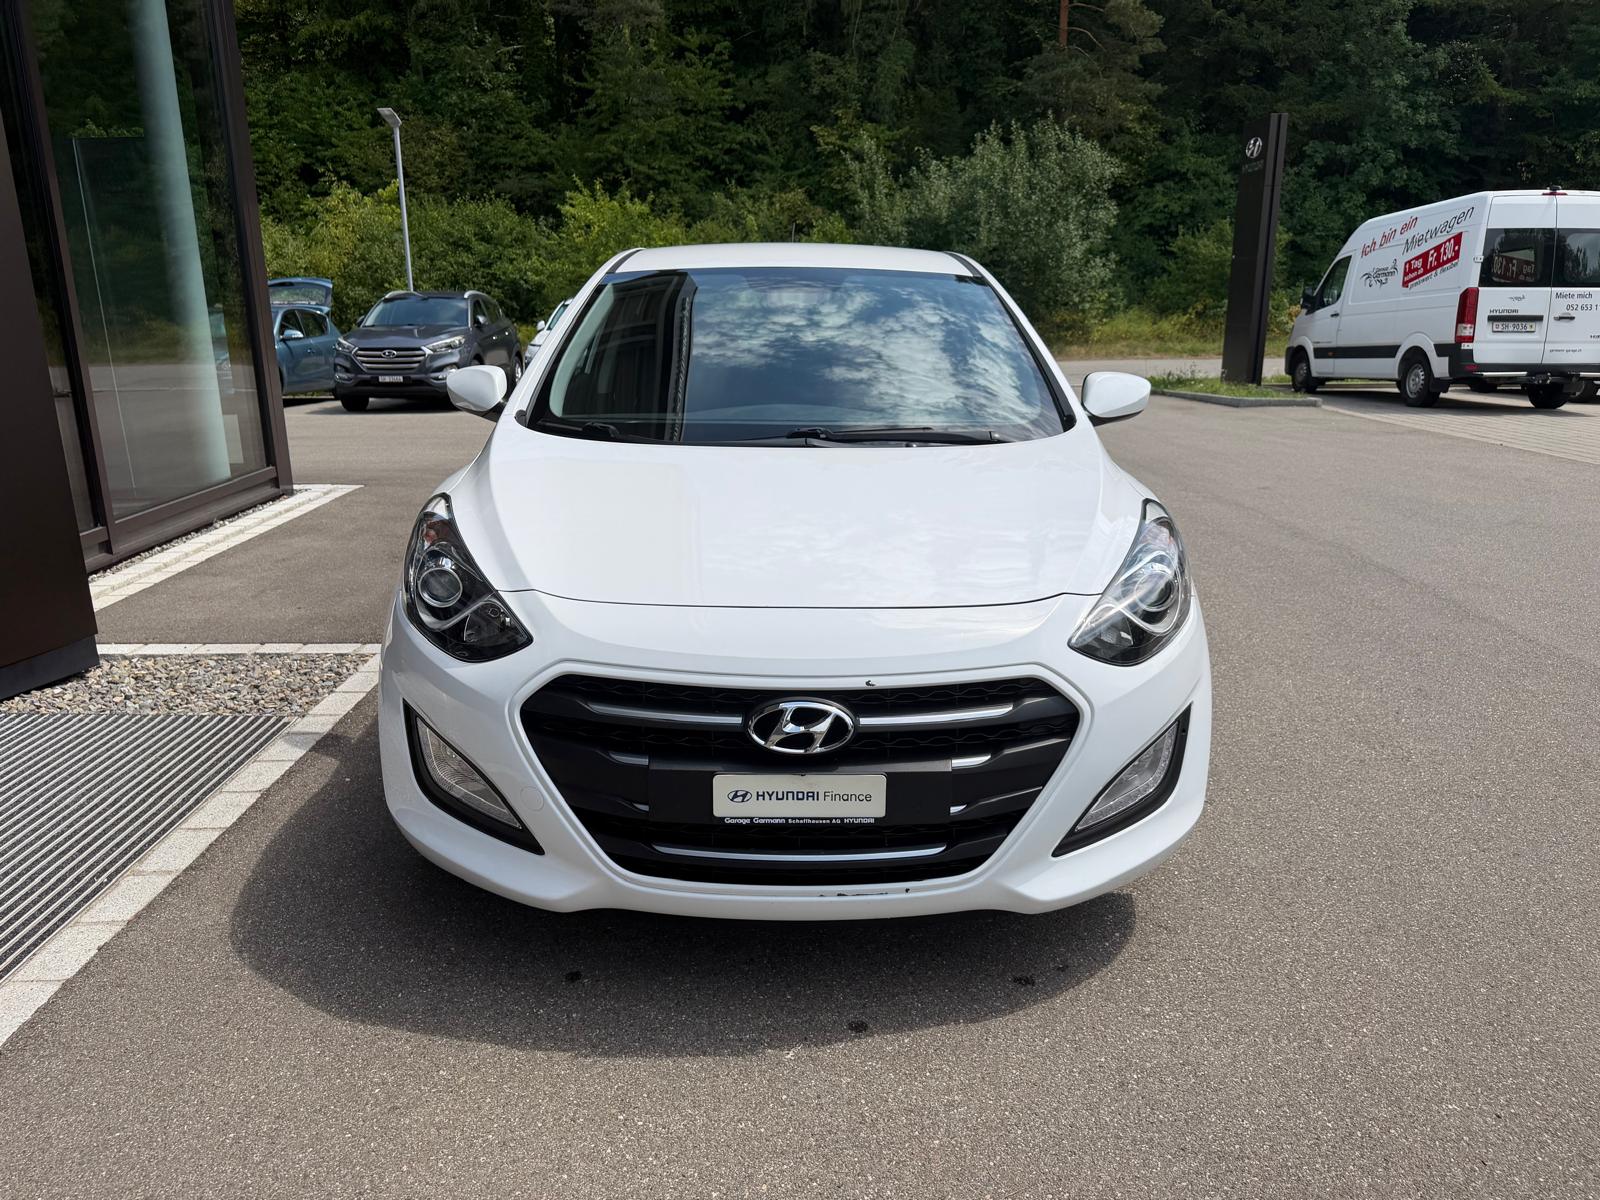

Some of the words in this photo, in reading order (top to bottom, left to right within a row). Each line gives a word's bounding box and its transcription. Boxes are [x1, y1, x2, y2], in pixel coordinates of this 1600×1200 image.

[1361, 237, 1377, 258] Ich
[1379, 227, 1397, 247] bin
[1400, 215, 1418, 235] ein
[1402, 206, 1475, 255] Mietwagen
[1411, 258, 1423, 270] Tag
[1427, 248, 1437, 269] Fr.
[1555, 292, 1575, 300] Miete
[1576, 291, 1593, 299] mich
[1566, 303, 1579, 311] 052
[1580, 303, 1593, 311] 653
[756, 790, 819, 801] HYUNDAI
[823, 790, 872, 802] Finance
[724, 817, 751, 825] Garage
